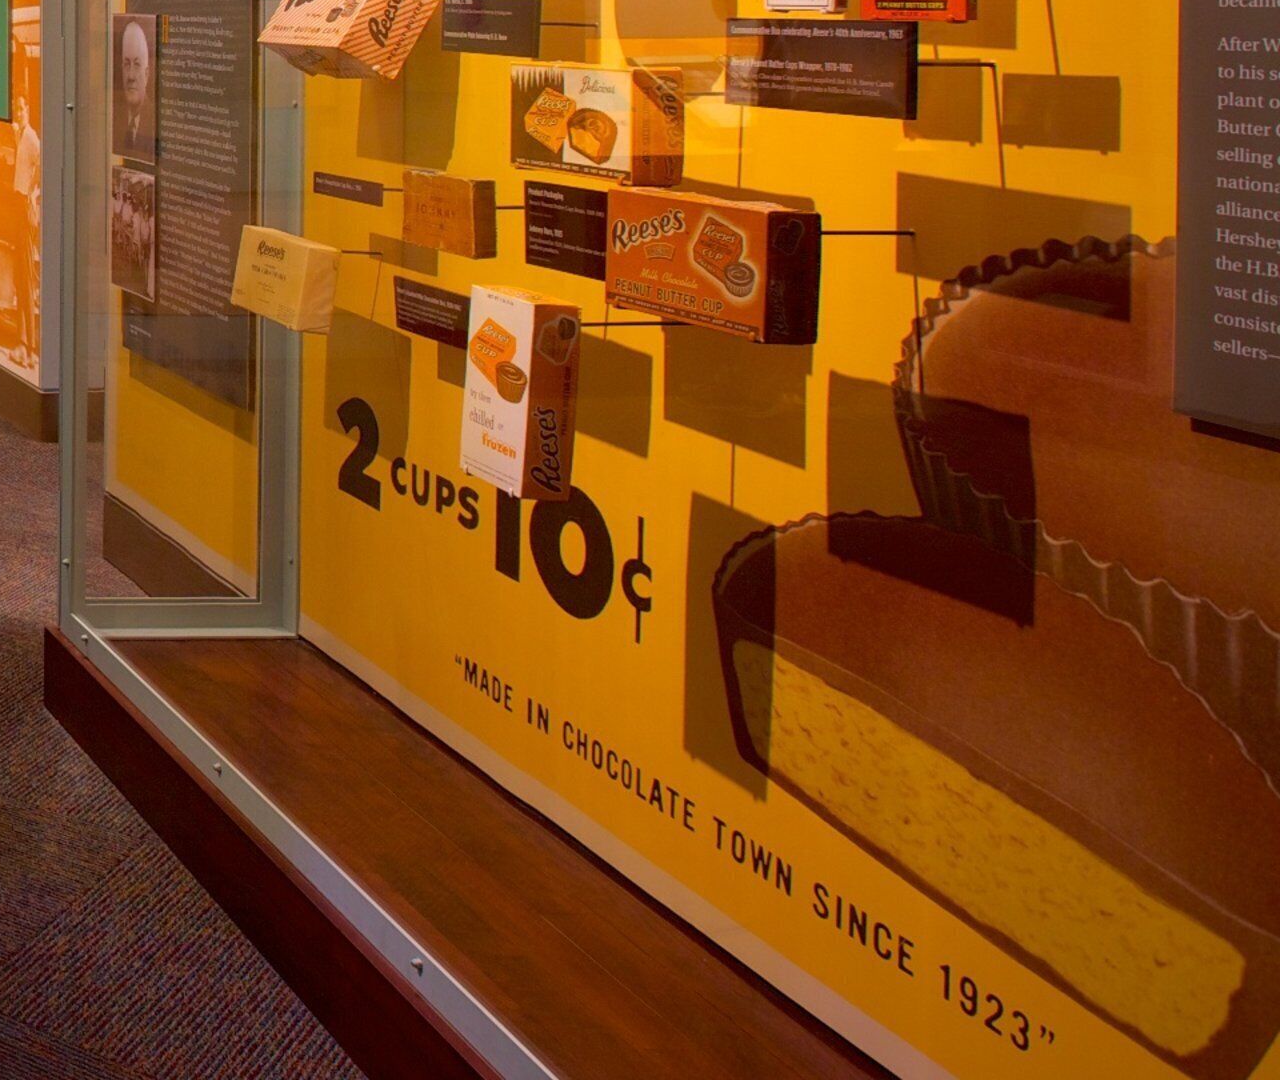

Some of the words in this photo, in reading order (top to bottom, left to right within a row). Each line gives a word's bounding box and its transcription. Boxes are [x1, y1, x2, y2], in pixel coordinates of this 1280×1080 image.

[1217, 36, 1259, 53] After
[1218, 65, 1235, 80] to
[1239, 64, 1265, 80] his
[1217, 93, 1264, 111] plant
[1217, 119, 1271, 137] Butter
[1216, 146, 1273, 169] selling
[612, 209, 686, 254] Reese's
[1215, 256, 1242, 273] the
[615, 278, 652, 297] PEANUT
[656, 287, 697, 309] BUTTER
[702, 297, 724, 315] CUP
[1214, 285, 1247, 302] vast
[469, 406, 495, 430] chilled
[481, 433, 517, 458] frozen
[530, 406, 563, 494] Reese's
[336, 397, 381, 512] 2
[390, 456, 479, 531] CUPS
[526, 697, 550, 736] IN
[561, 720, 696, 833] CHOCOLATE
[712, 815, 793, 896] TOWN
[812, 881, 916, 978] SINCE
